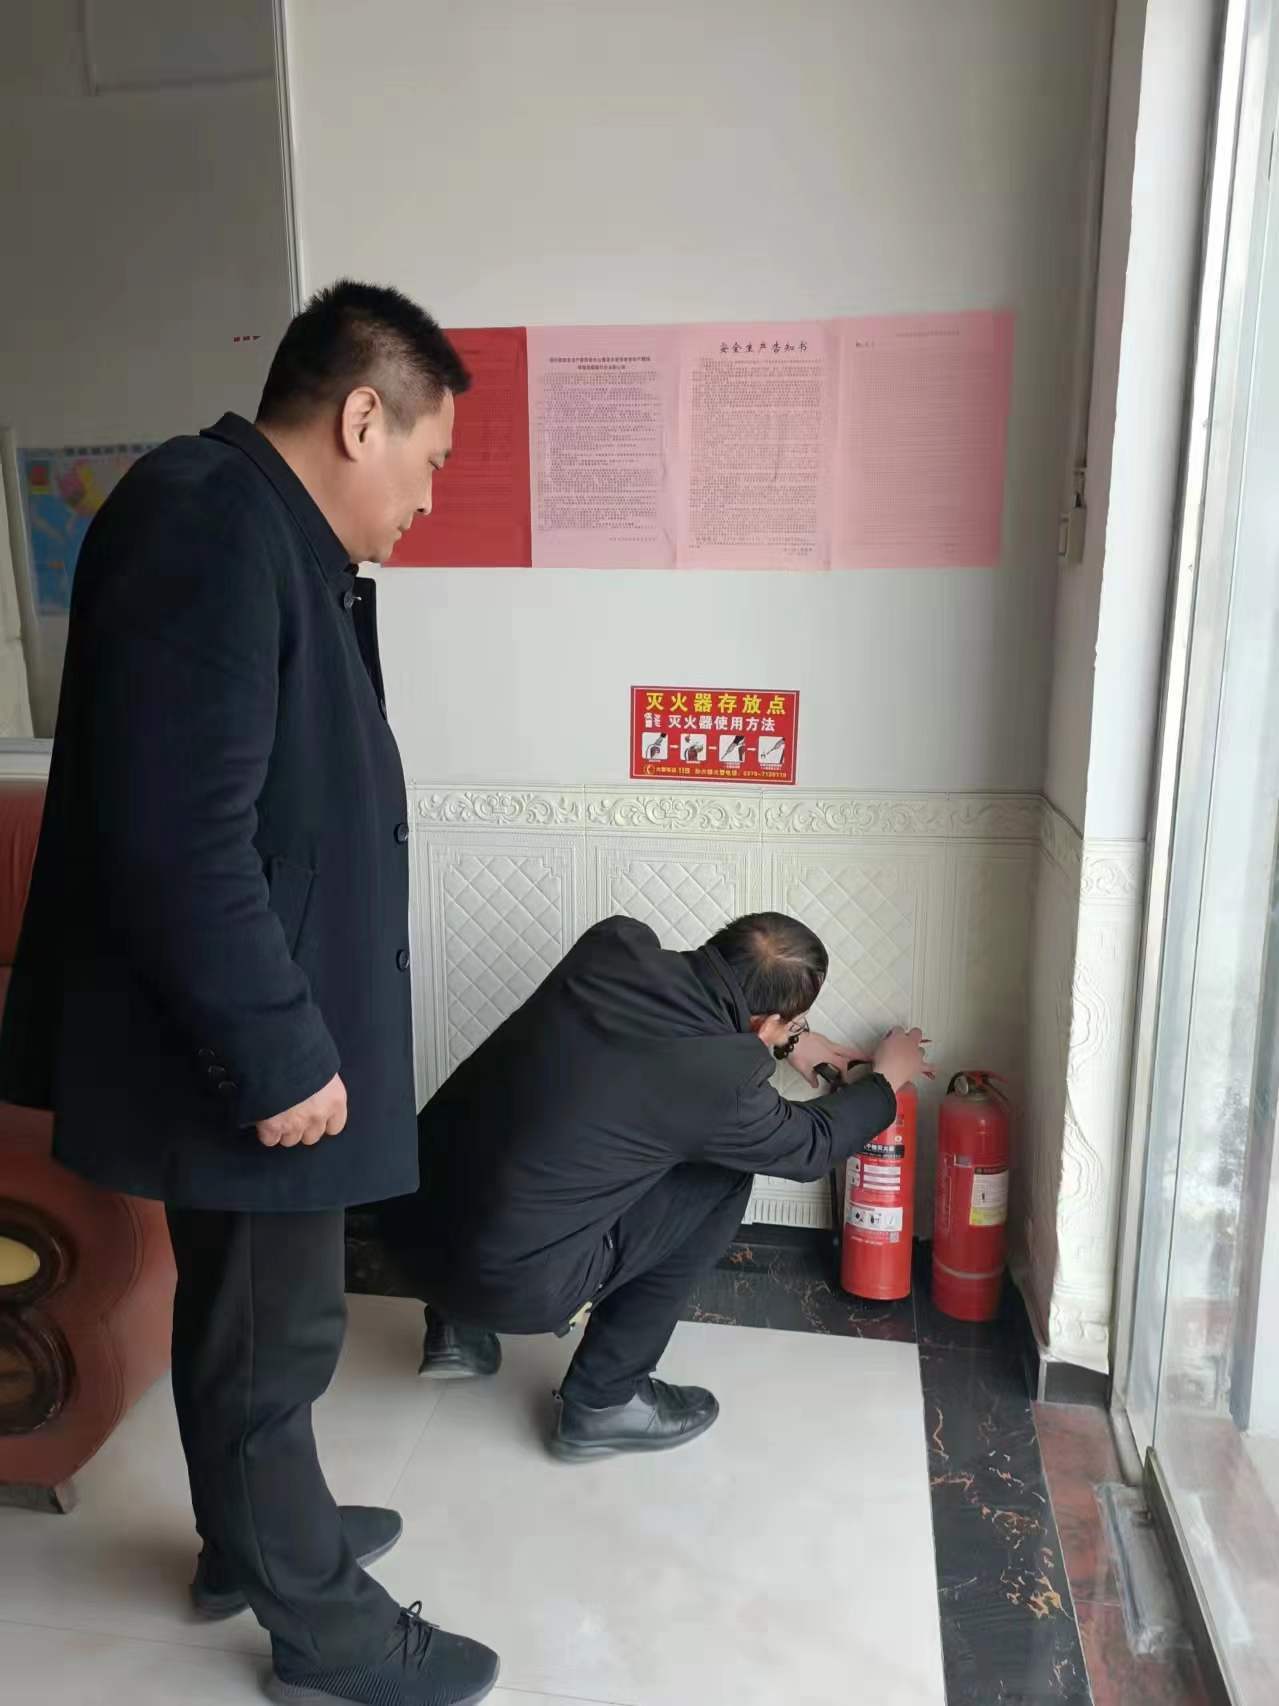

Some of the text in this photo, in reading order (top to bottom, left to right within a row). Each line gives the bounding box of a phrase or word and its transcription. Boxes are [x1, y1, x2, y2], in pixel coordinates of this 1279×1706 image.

[720, 341, 808, 353] 安全生产告知书
[646, 692, 786, 714] 灭火器存放点
[668, 714, 776, 732] 灭火器使用方法
